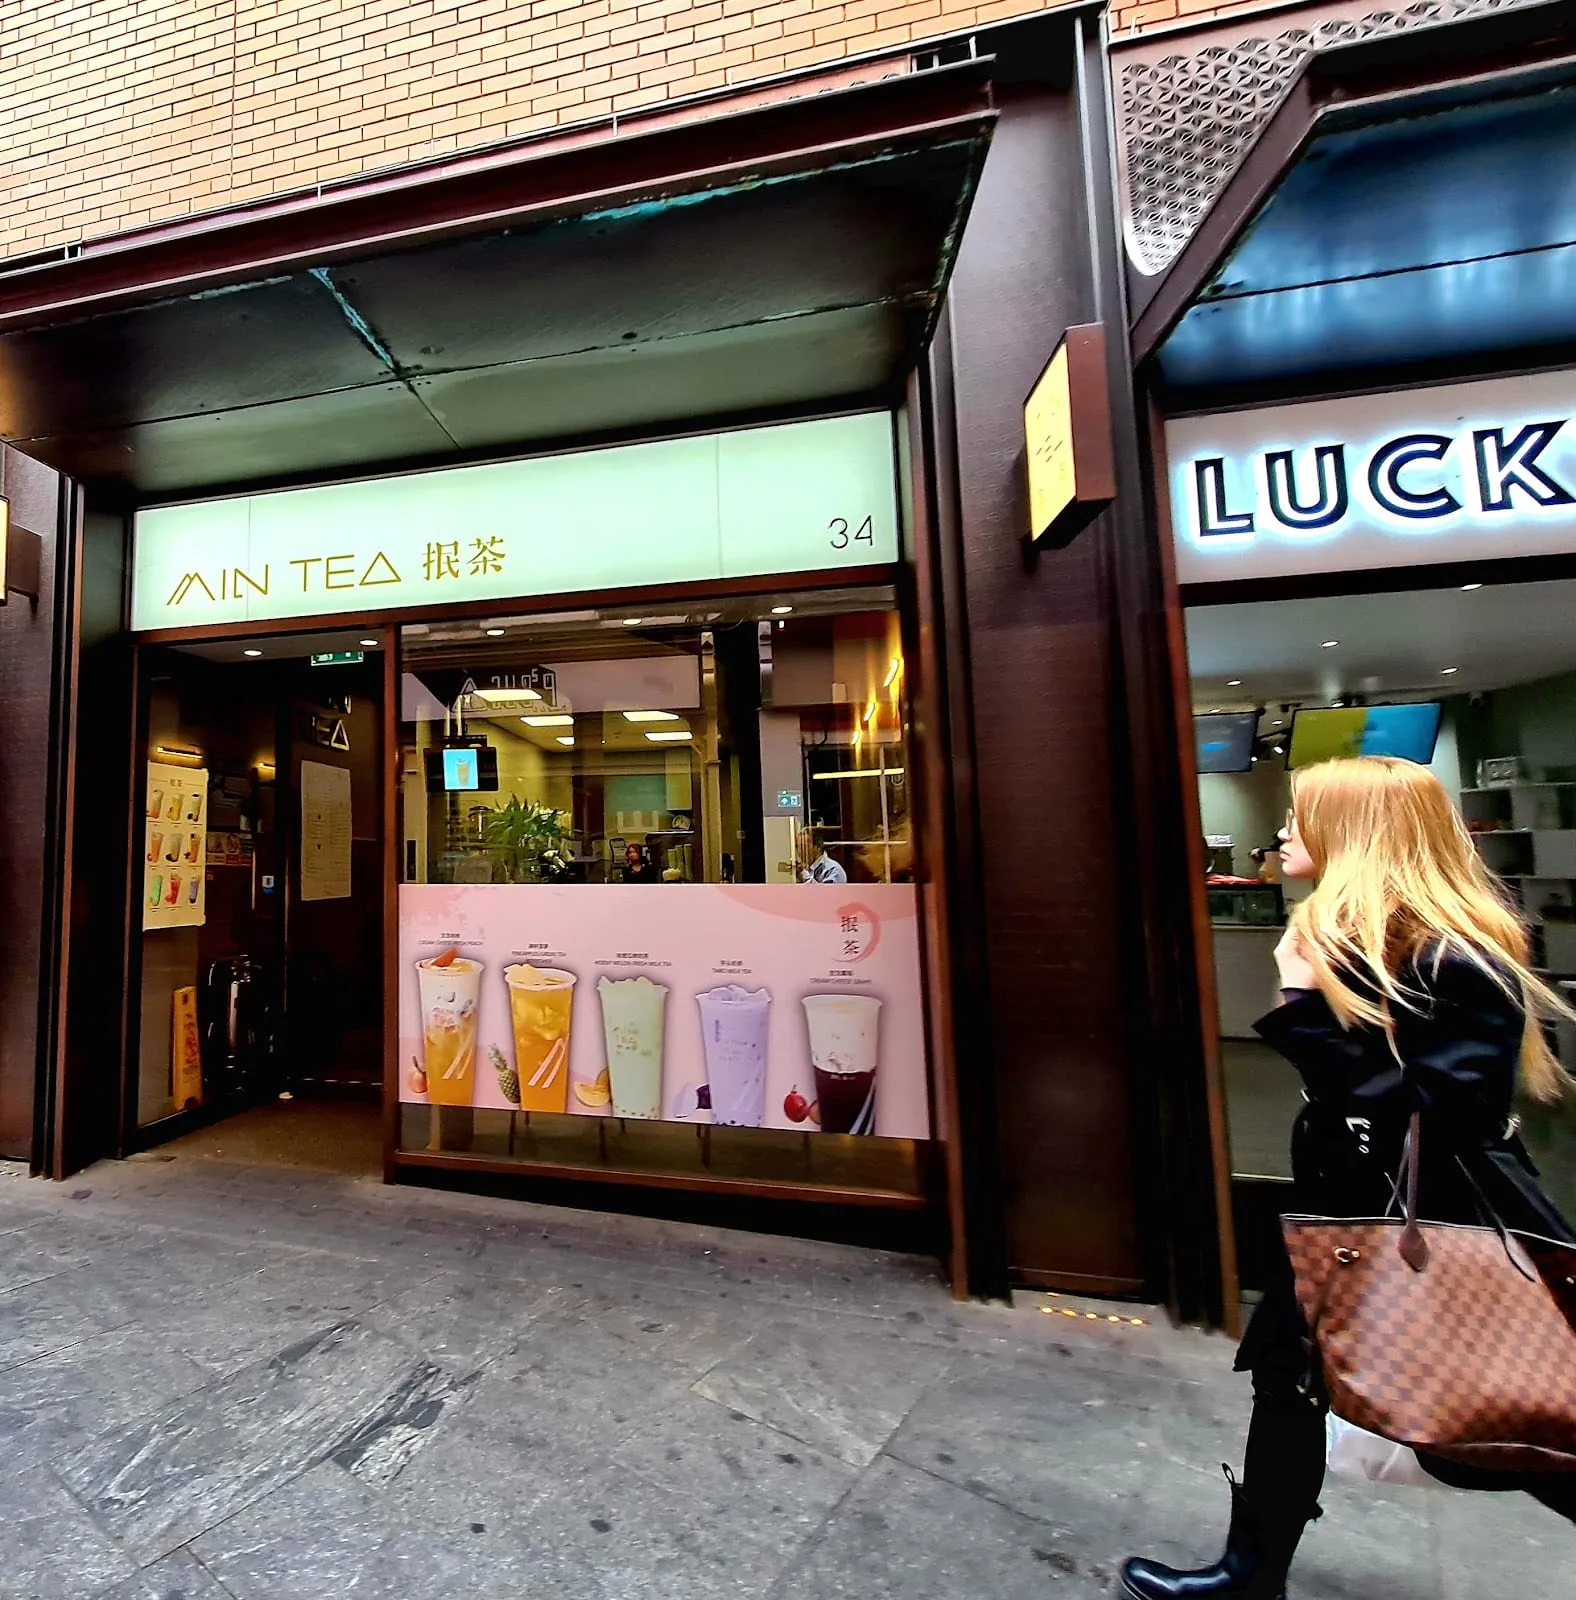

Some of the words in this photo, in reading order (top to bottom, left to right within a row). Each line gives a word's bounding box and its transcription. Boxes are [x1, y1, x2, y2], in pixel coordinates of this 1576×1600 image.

[1194, 419, 1576, 537] LUCK
[828, 514, 873, 549] 34
[166, 564, 269, 605] MIN
[289, 551, 402, 593] TEA
[422, 536, 506, 581] 抿茶
